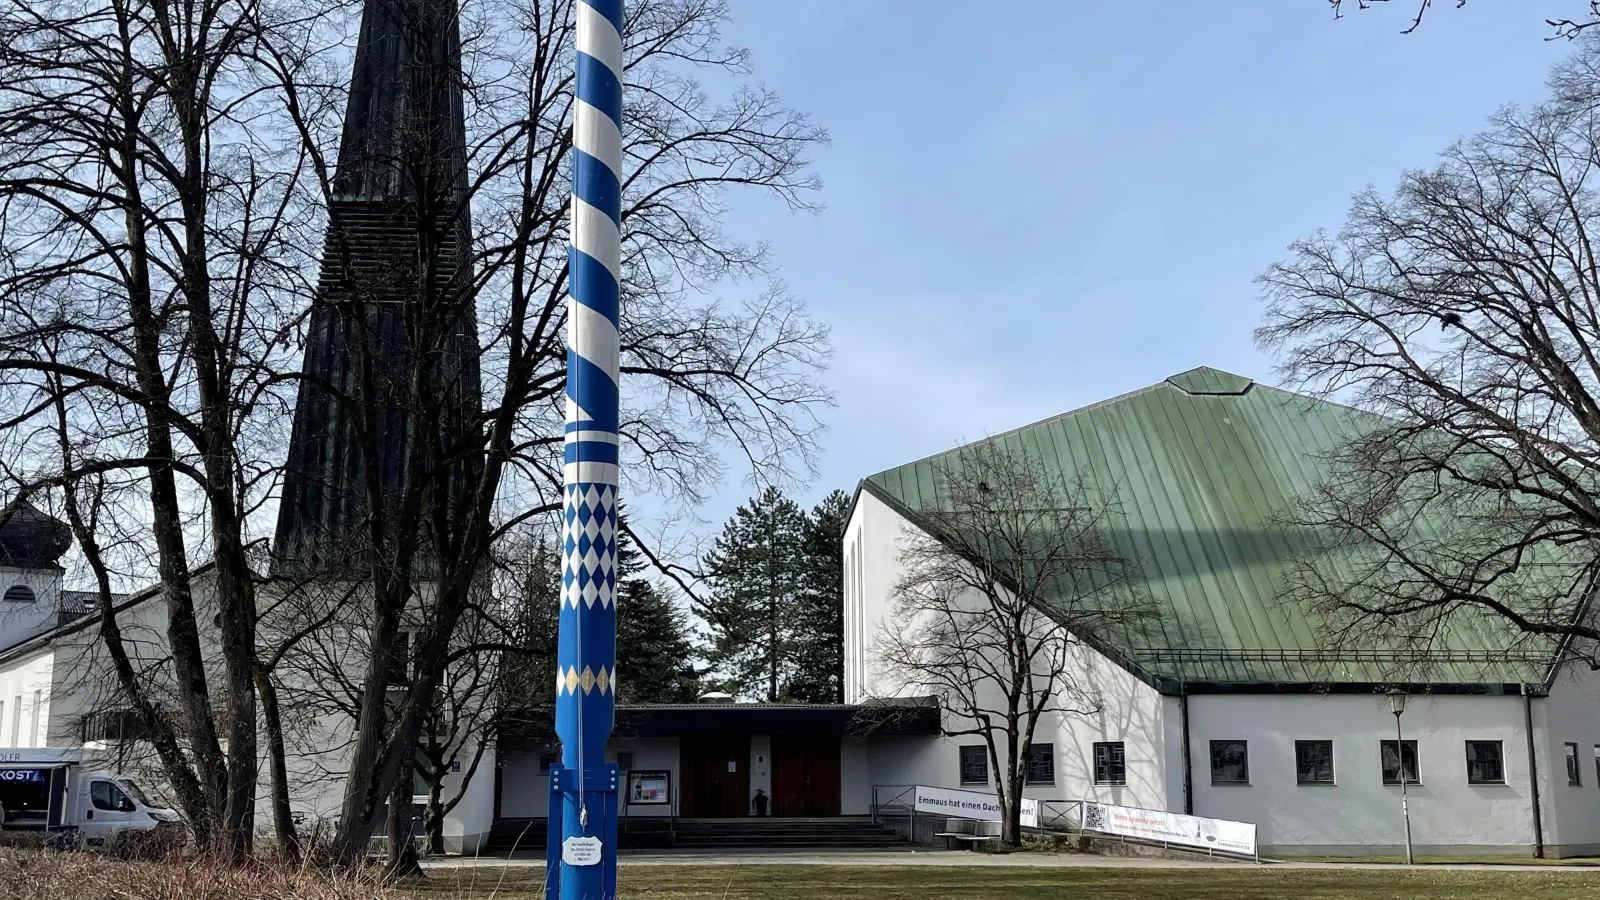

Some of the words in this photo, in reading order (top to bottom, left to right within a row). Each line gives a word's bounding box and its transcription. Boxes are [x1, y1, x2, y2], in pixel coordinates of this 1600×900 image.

[918, 796, 948, 806] Emmaus
[948, 798, 961, 808] hat
[961, 800, 981, 810] einen
